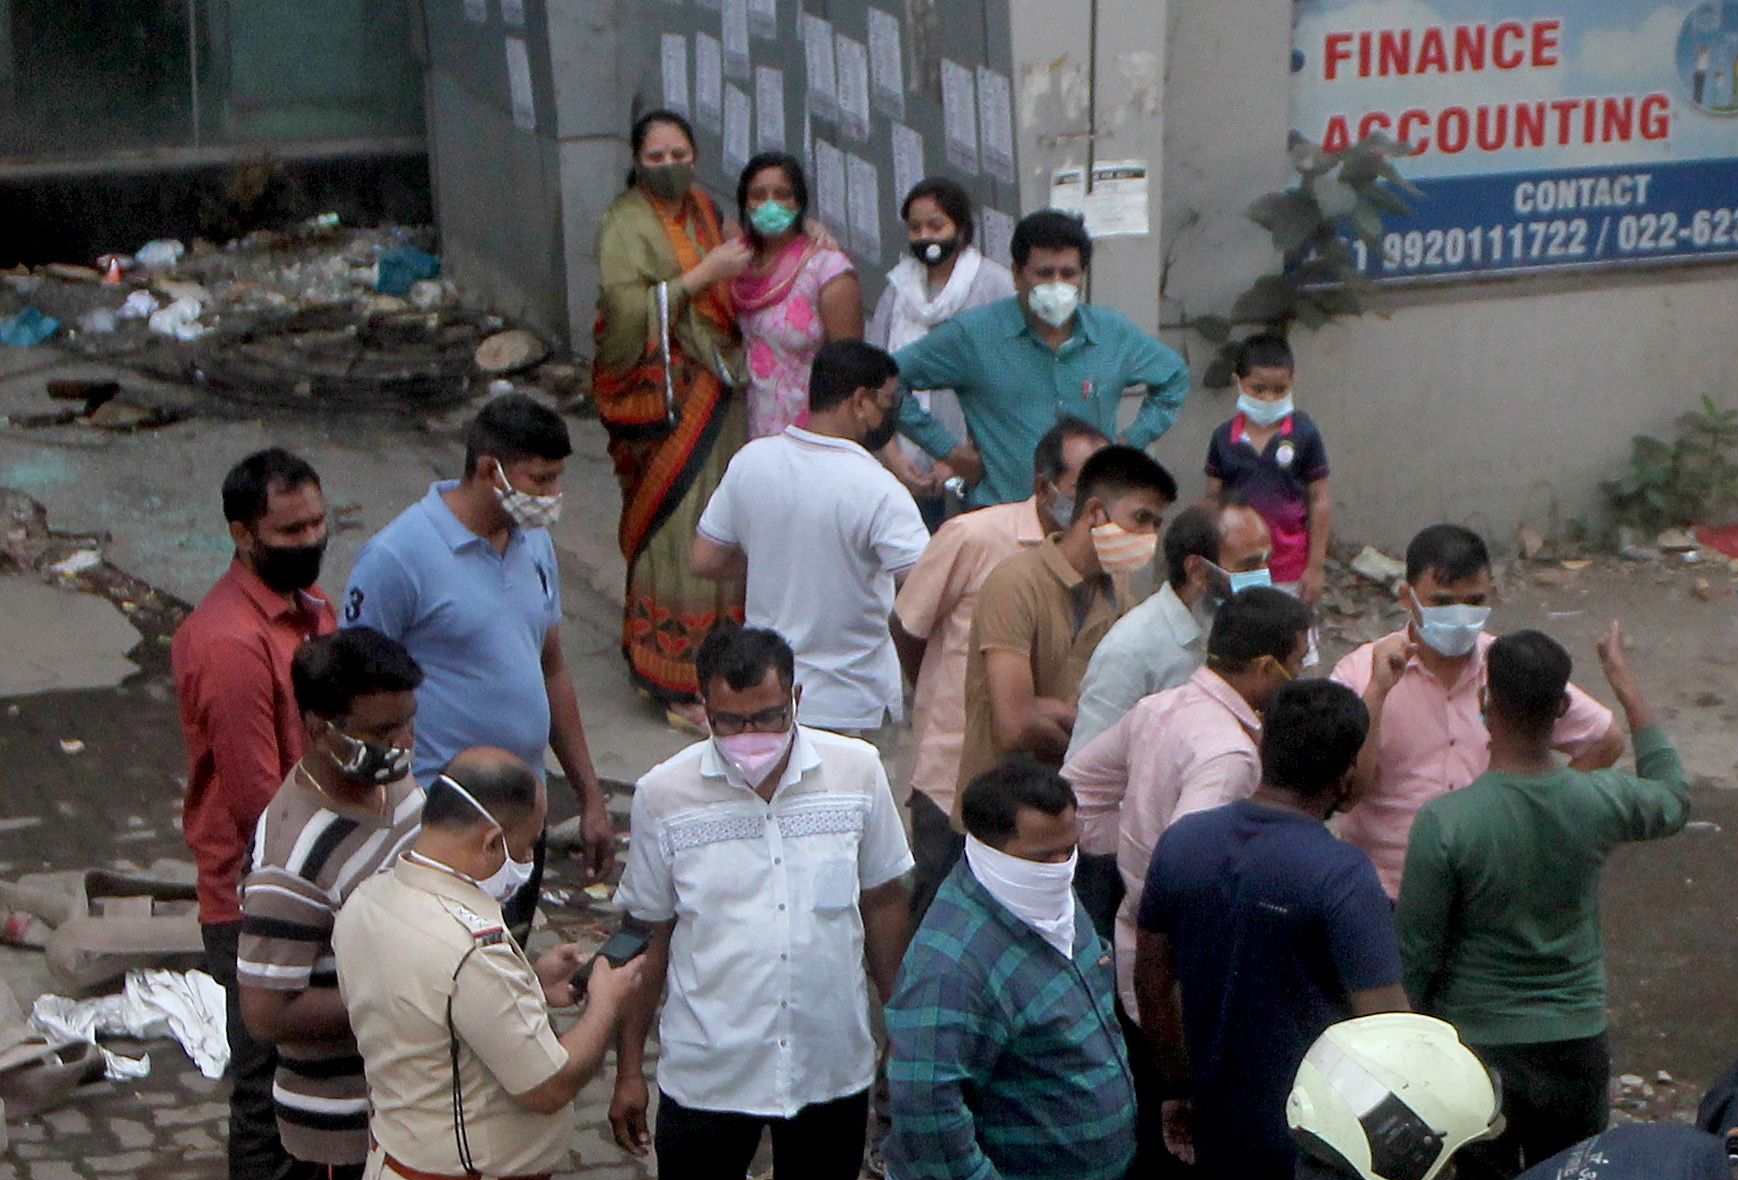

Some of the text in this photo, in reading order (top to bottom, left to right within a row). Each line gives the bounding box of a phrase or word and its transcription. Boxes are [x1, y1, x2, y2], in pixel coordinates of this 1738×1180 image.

[1323, 20, 1561, 81] FINANCE
[1322, 93, 1670, 157] ACCOUNTING
[1514, 173, 1652, 214] CONTACT
[1383, 217, 1588, 270] 9920111722
[345, 587, 364, 622] 3
